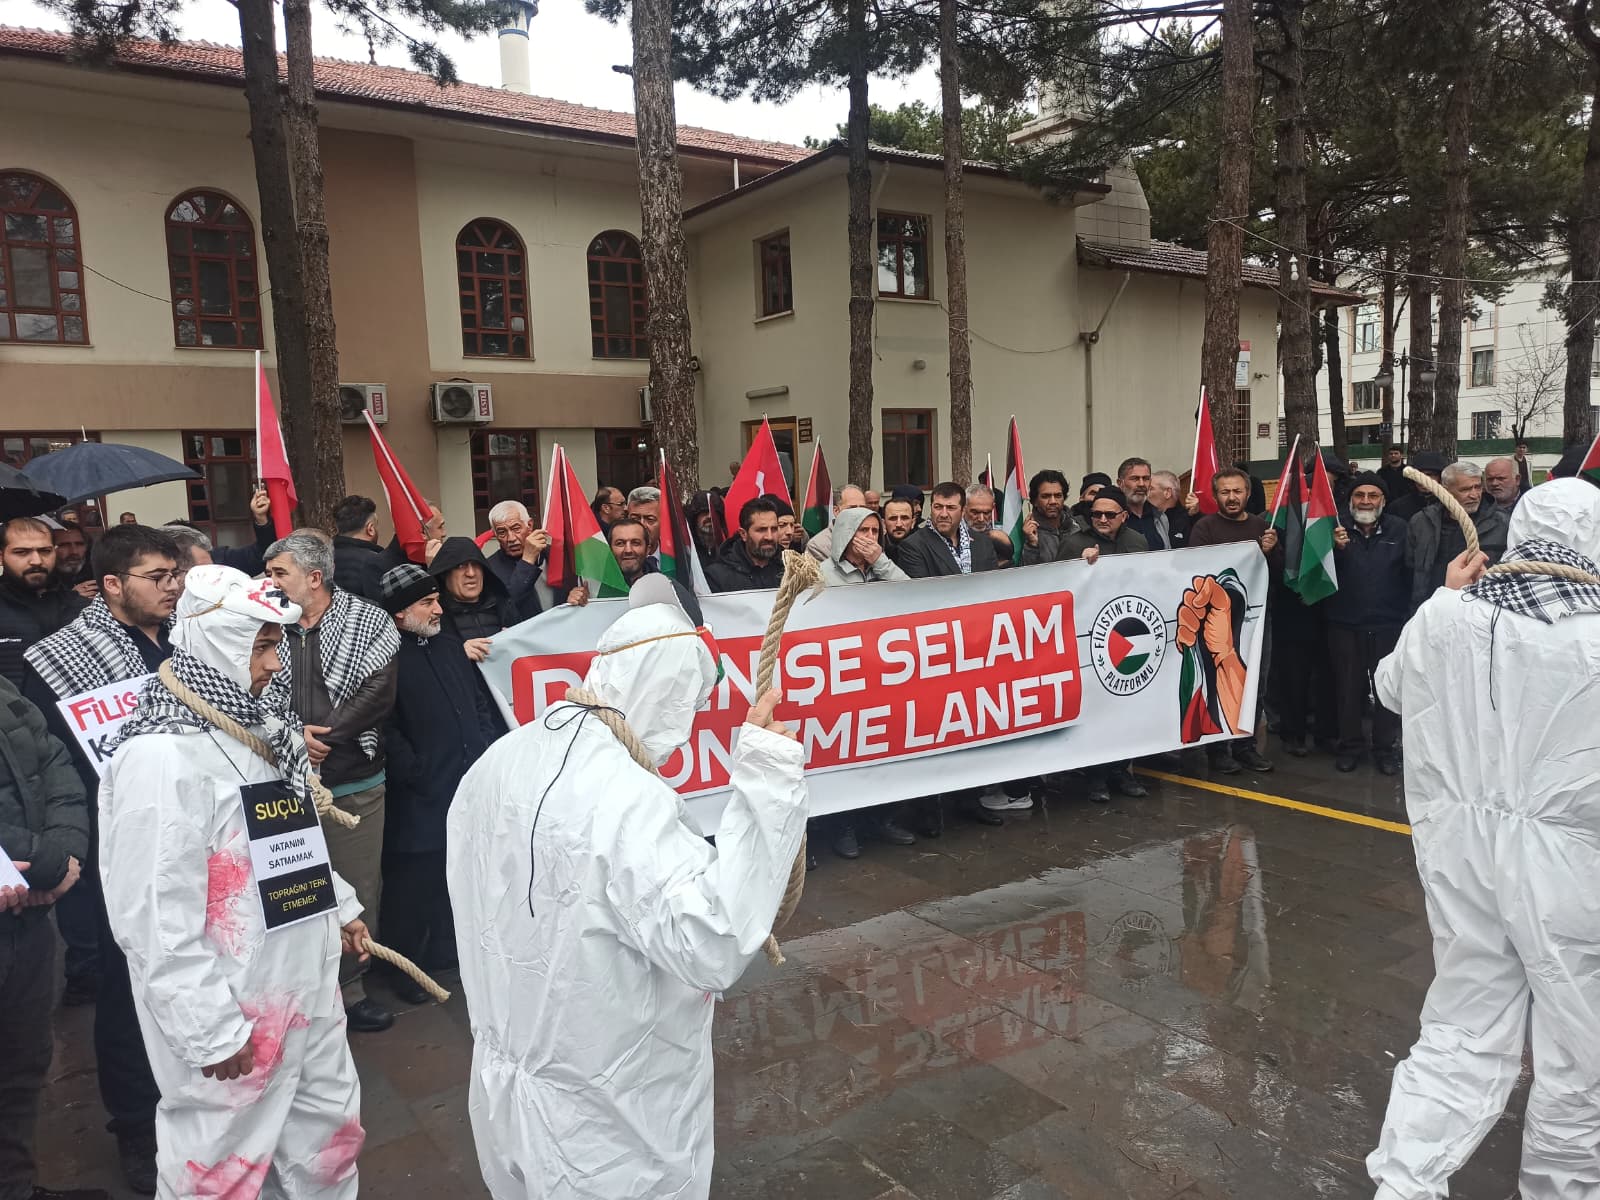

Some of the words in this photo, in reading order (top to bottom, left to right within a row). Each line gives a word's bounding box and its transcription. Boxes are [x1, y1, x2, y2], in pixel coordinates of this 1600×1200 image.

[1093, 601, 1132, 648] FİLİSTİN'E
[1136, 602, 1164, 640] DESTEK
[878, 604, 1065, 686] SELAM
[1105, 664, 1154, 692] PLATFORMU
[904, 670, 1074, 749] LANET
[269, 837, 305, 853] VATANINI
[268, 850, 314, 869] SATMAMAK
[268, 882, 308, 901] TOPRAĞINI
[309, 877, 328, 889] TERK
[282, 894, 318, 912] ETMEMEK
